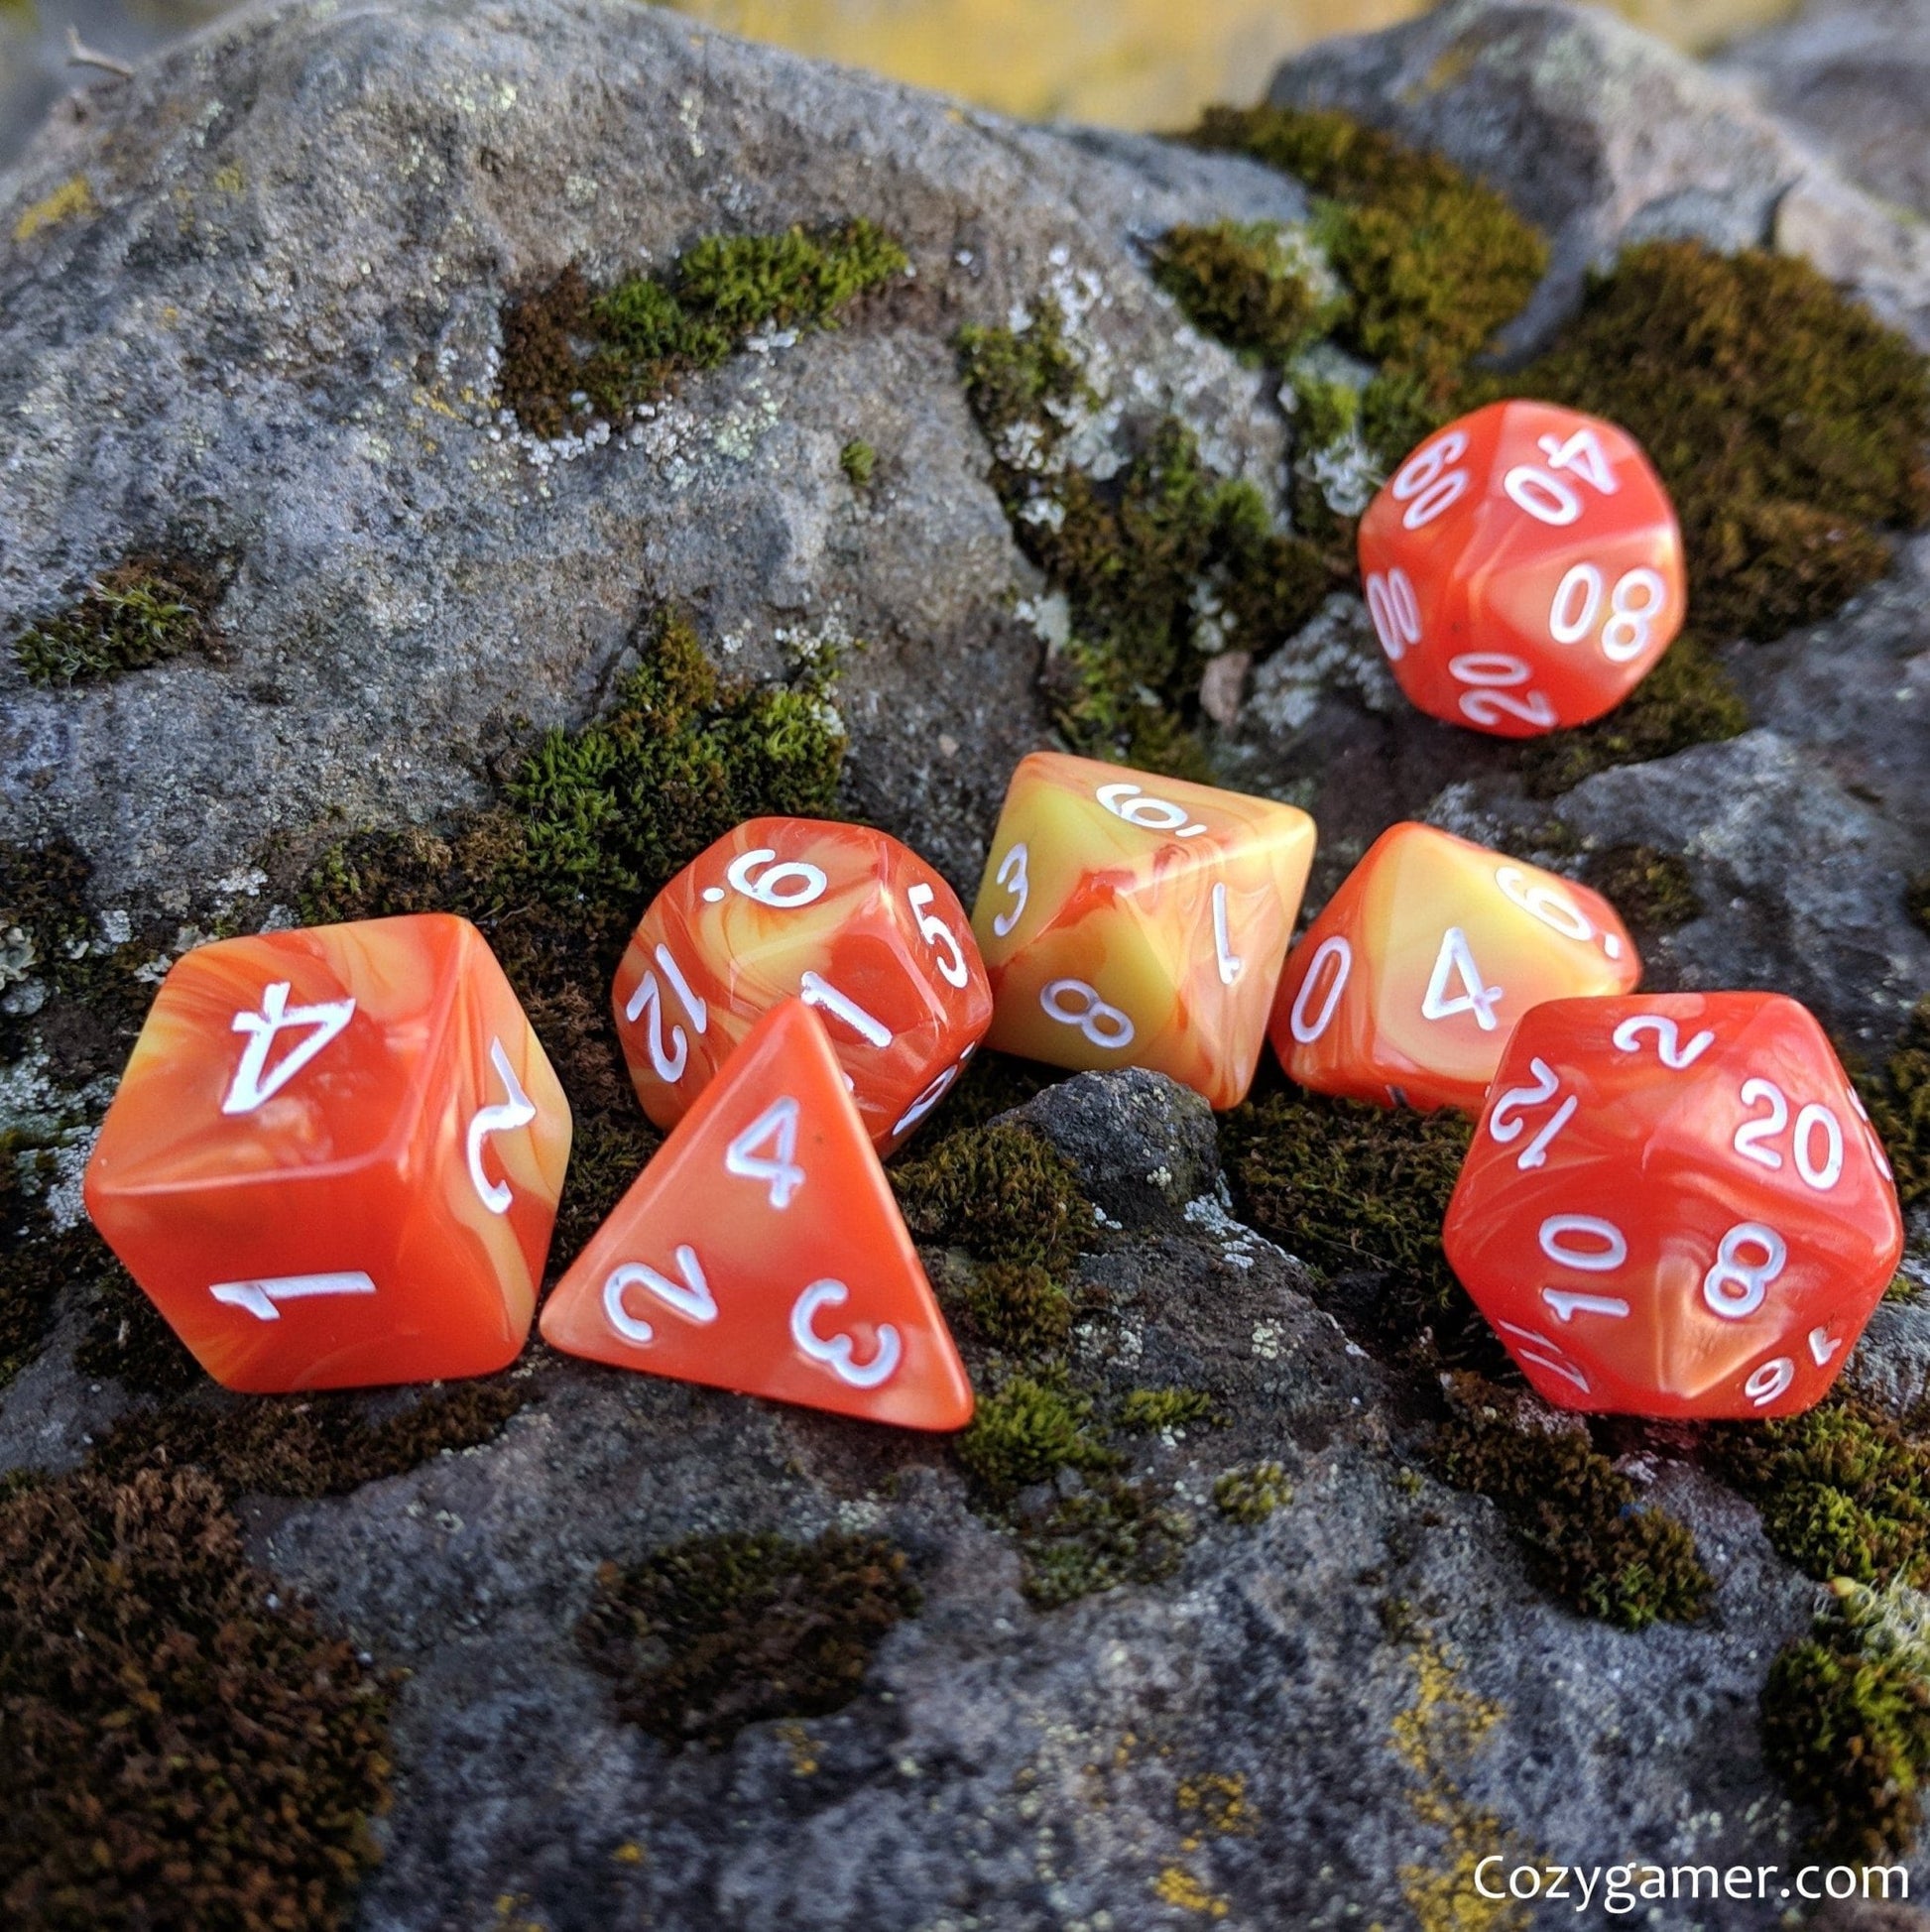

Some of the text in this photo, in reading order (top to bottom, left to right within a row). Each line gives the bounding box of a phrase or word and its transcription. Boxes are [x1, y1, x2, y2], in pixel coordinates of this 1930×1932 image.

[1504, 428, 1622, 527] 40
[1549, 563, 1666, 664] 80
[1448, 652, 1558, 727] 20
[907, 883, 969, 990] 5
[993, 843, 1027, 937] 3
[1213, 882, 1243, 985] 1
[625, 942, 707, 1083] 12
[1039, 977, 1136, 1049] 8
[1290, 935, 1353, 1044] 0
[1421, 926, 1504, 1031] 4
[221, 981, 357, 1116] 4
[1612, 1014, 1716, 1069] 2
[467, 1034, 537, 1214] 2
[725, 1095, 806, 1210] 4
[1490, 1057, 1578, 1170] 12
[1734, 1077, 1844, 1190] 20
[208, 1270, 377, 1322] 1
[603, 1245, 719, 1345] 2
[1538, 1214, 1630, 1322] 10
[1702, 1221, 1786, 1320] 8
[790, 1278, 903, 1388] 3
